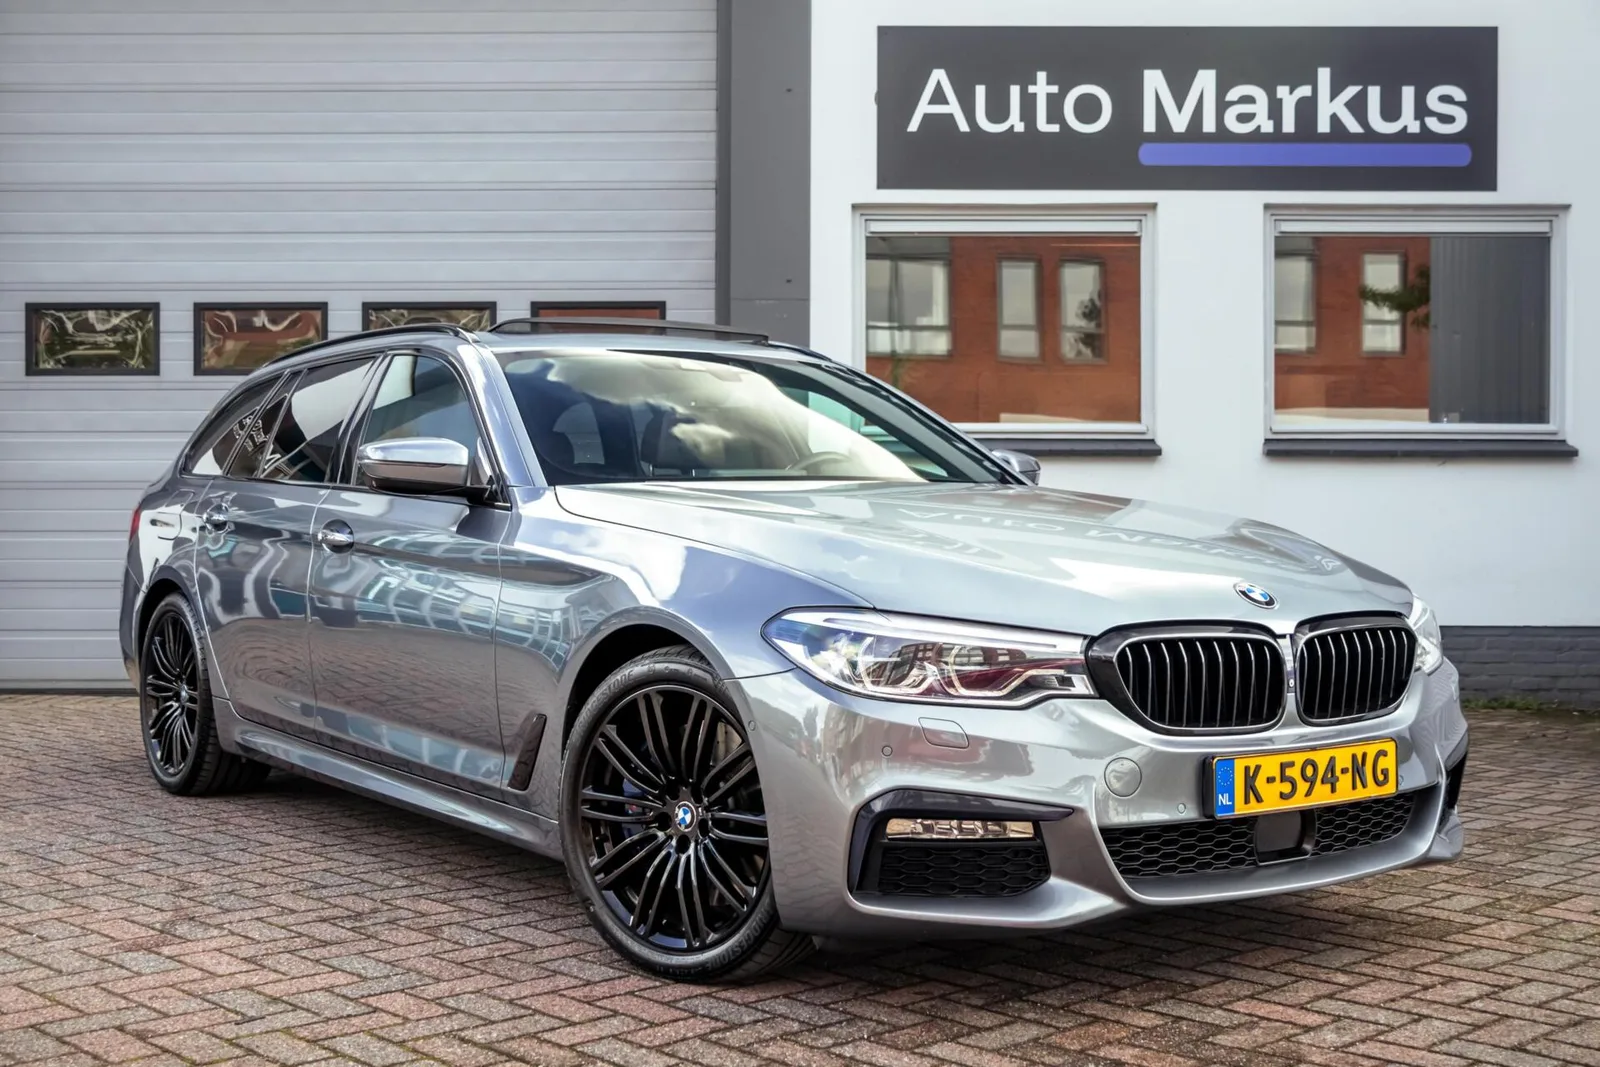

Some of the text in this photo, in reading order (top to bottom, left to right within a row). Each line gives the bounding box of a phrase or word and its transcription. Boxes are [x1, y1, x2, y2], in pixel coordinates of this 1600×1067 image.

[907, 67, 1468, 134] Auto Markus
[1218, 793, 1232, 806] NL
[1243, 749, 1390, 805] K-594-NG
